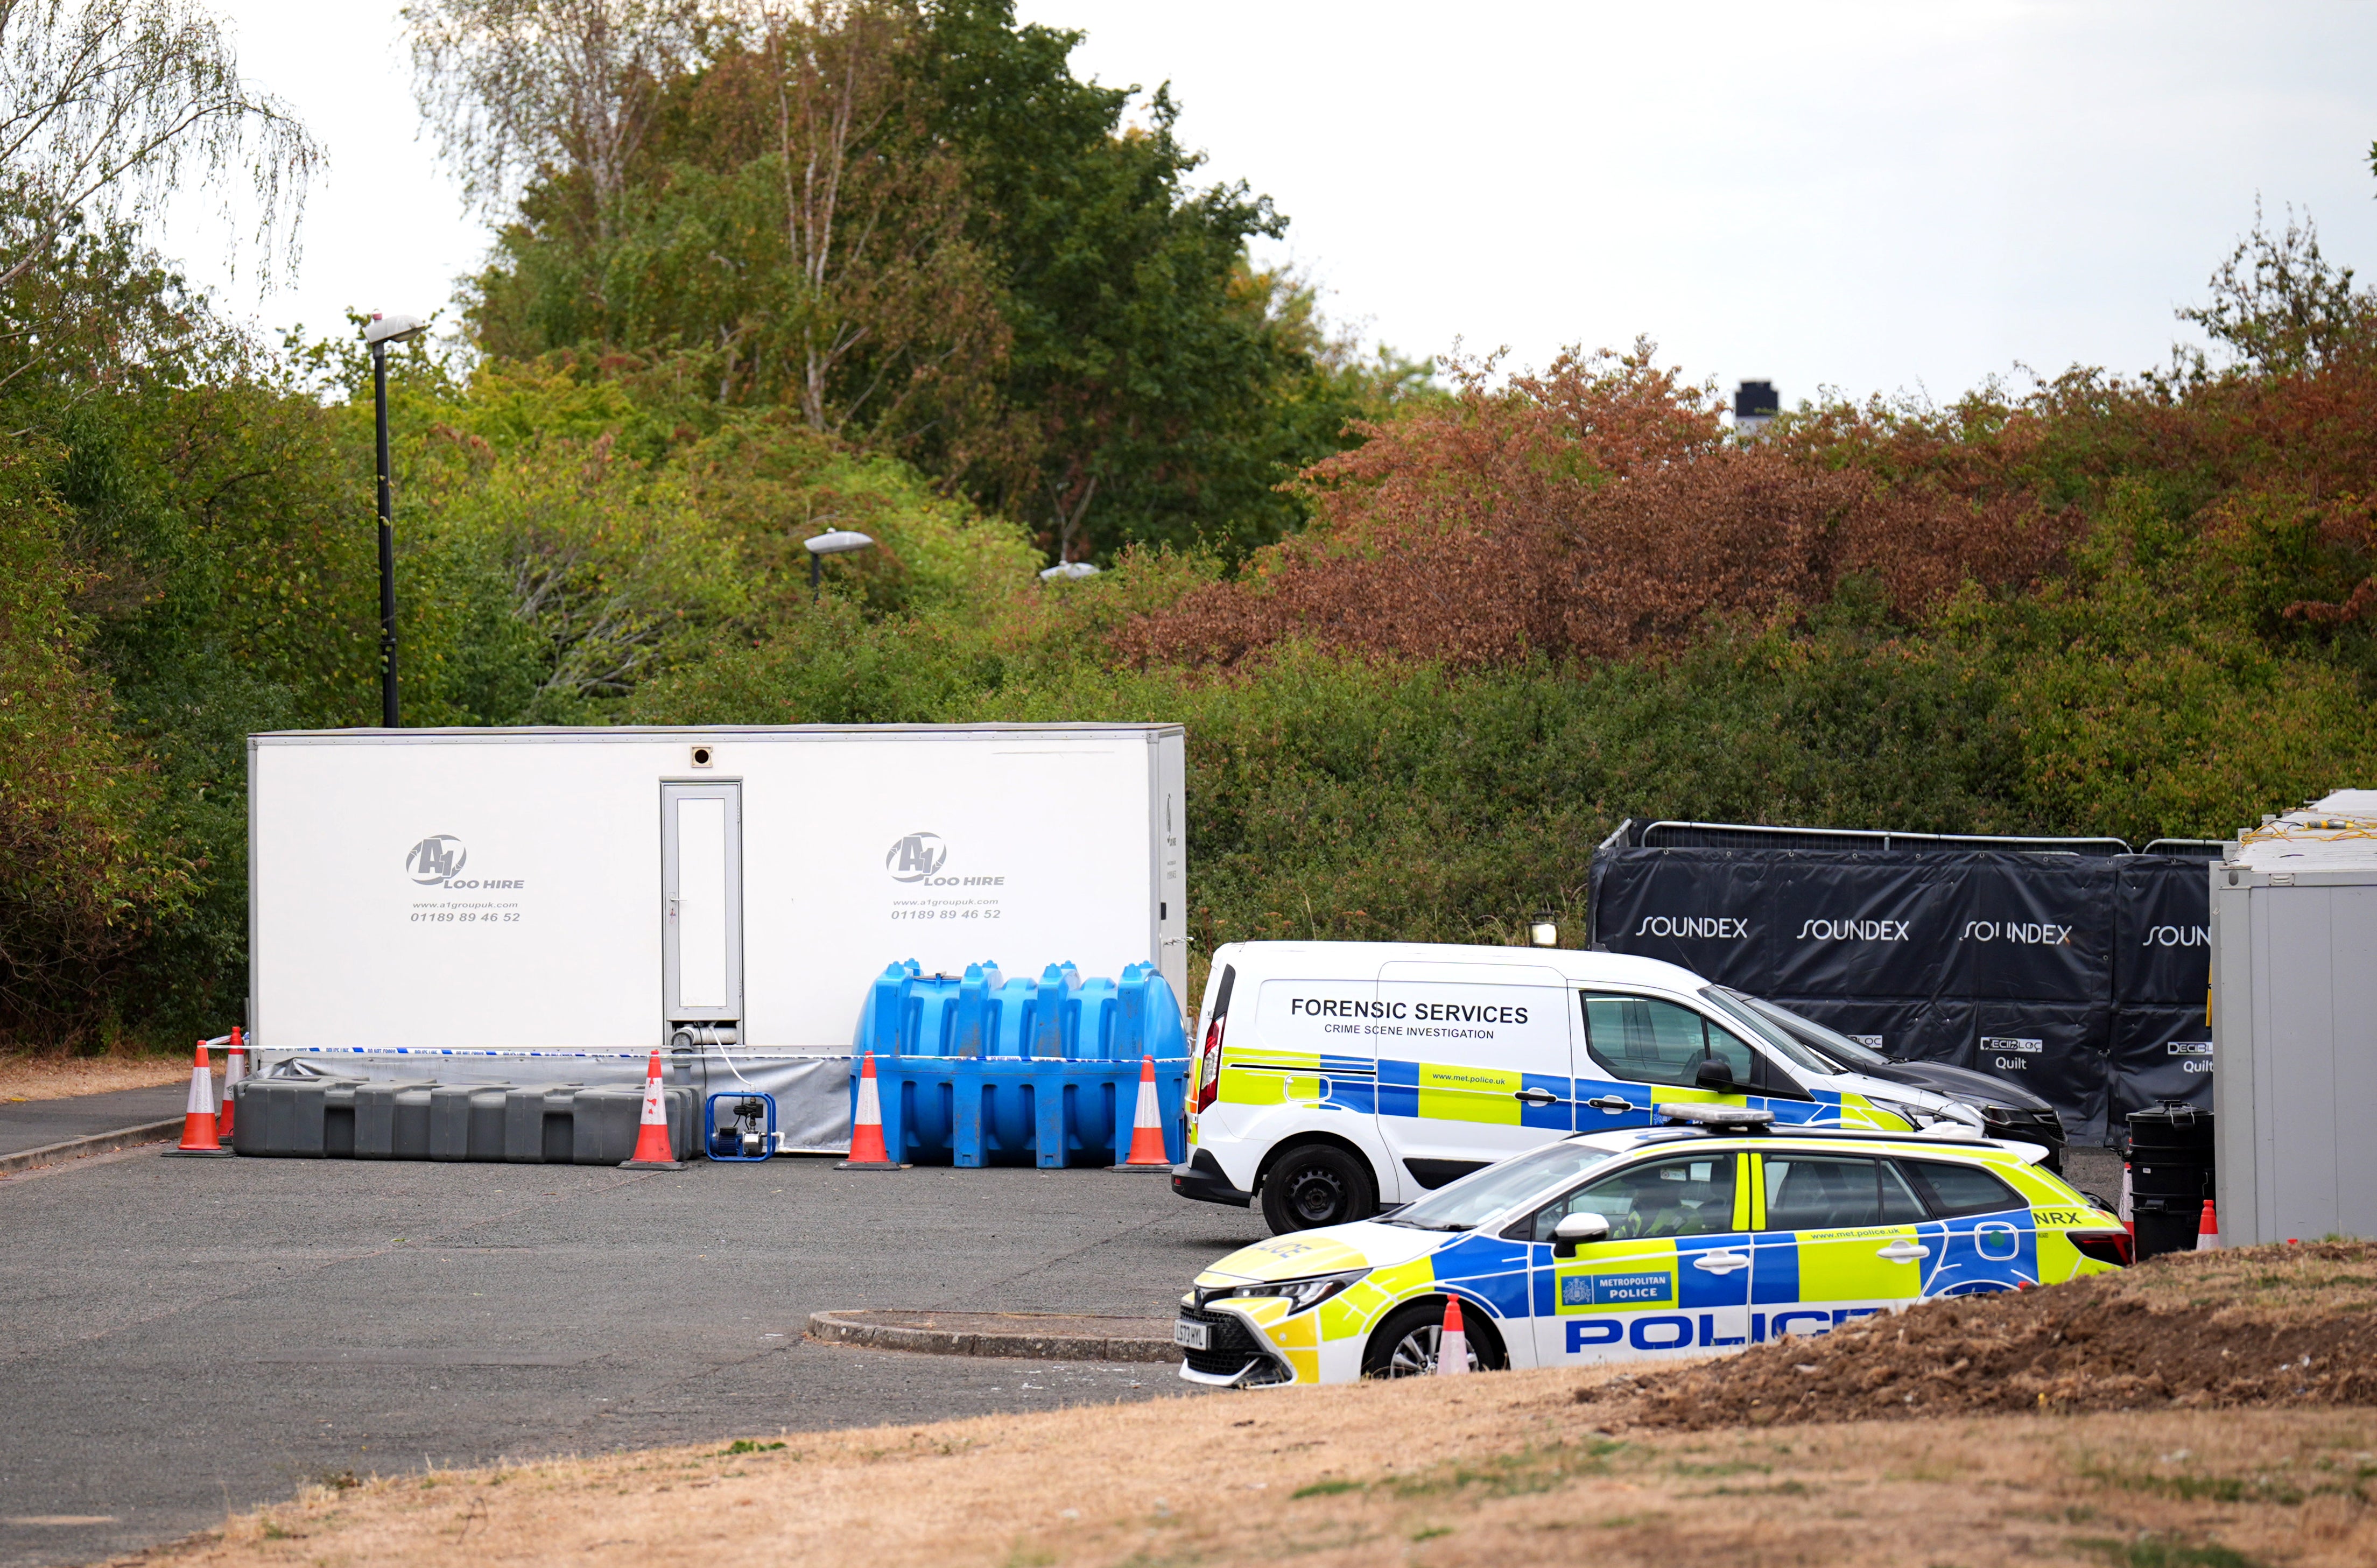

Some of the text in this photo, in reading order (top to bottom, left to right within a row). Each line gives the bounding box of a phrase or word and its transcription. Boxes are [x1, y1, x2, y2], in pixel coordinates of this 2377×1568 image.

[418, 838, 454, 876] A1
[898, 835, 934, 874] A1
[443, 880, 525, 889] LOO HIRE
[923, 876, 1005, 887] LOO HIRE
[413, 901, 518, 910] www.a1groupuk.com
[893, 898, 998, 907] www.a1groupuk.com
[410, 912, 521, 922] 01189 89 46 52
[891, 909, 1001, 919] 01189 89 46 52
[1635, 916, 1748, 938] SOUNDEX
[1796, 919, 1910, 941] SOUNDEX
[2142, 925, 2211, 947] SOUN
[1292, 999, 1528, 1024] FORENSIC SERVICES
[1325, 1024, 1494, 1039] CRIME SCENE INVESTIGATION
[2169, 1042, 2213, 1054] DECIBL
[1995, 1056, 2027, 1070] Quilt
[2183, 1059, 2213, 1073] Quilt
[1432, 1073, 1505, 1086] www.met.police.uk
[2033, 1212, 2082, 1225] NRX
[1811, 1228, 1900, 1239] www.met.police.uk
[1599, 1275, 1666, 1287] METROPOLITAN
[1609, 1287, 1657, 1299] POLICE
